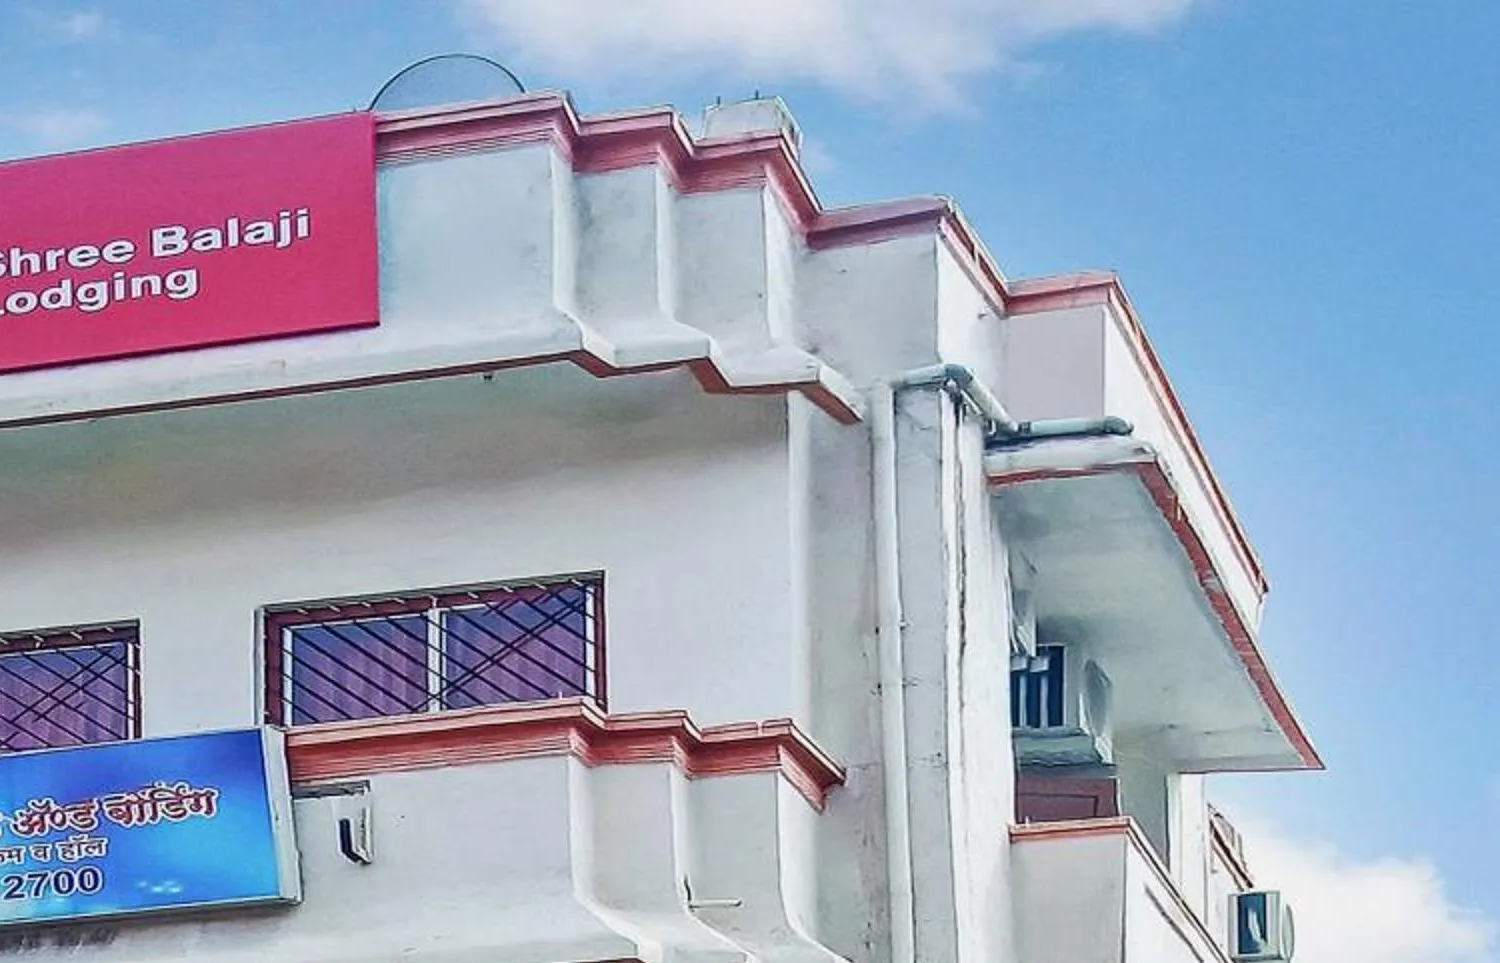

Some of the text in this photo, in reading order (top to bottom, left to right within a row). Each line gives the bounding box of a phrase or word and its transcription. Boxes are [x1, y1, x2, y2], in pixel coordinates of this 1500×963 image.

[149, 207, 311, 259] Balaji
[31, 842, 51, 861] व
[59, 836, 106, 861] हॉल
